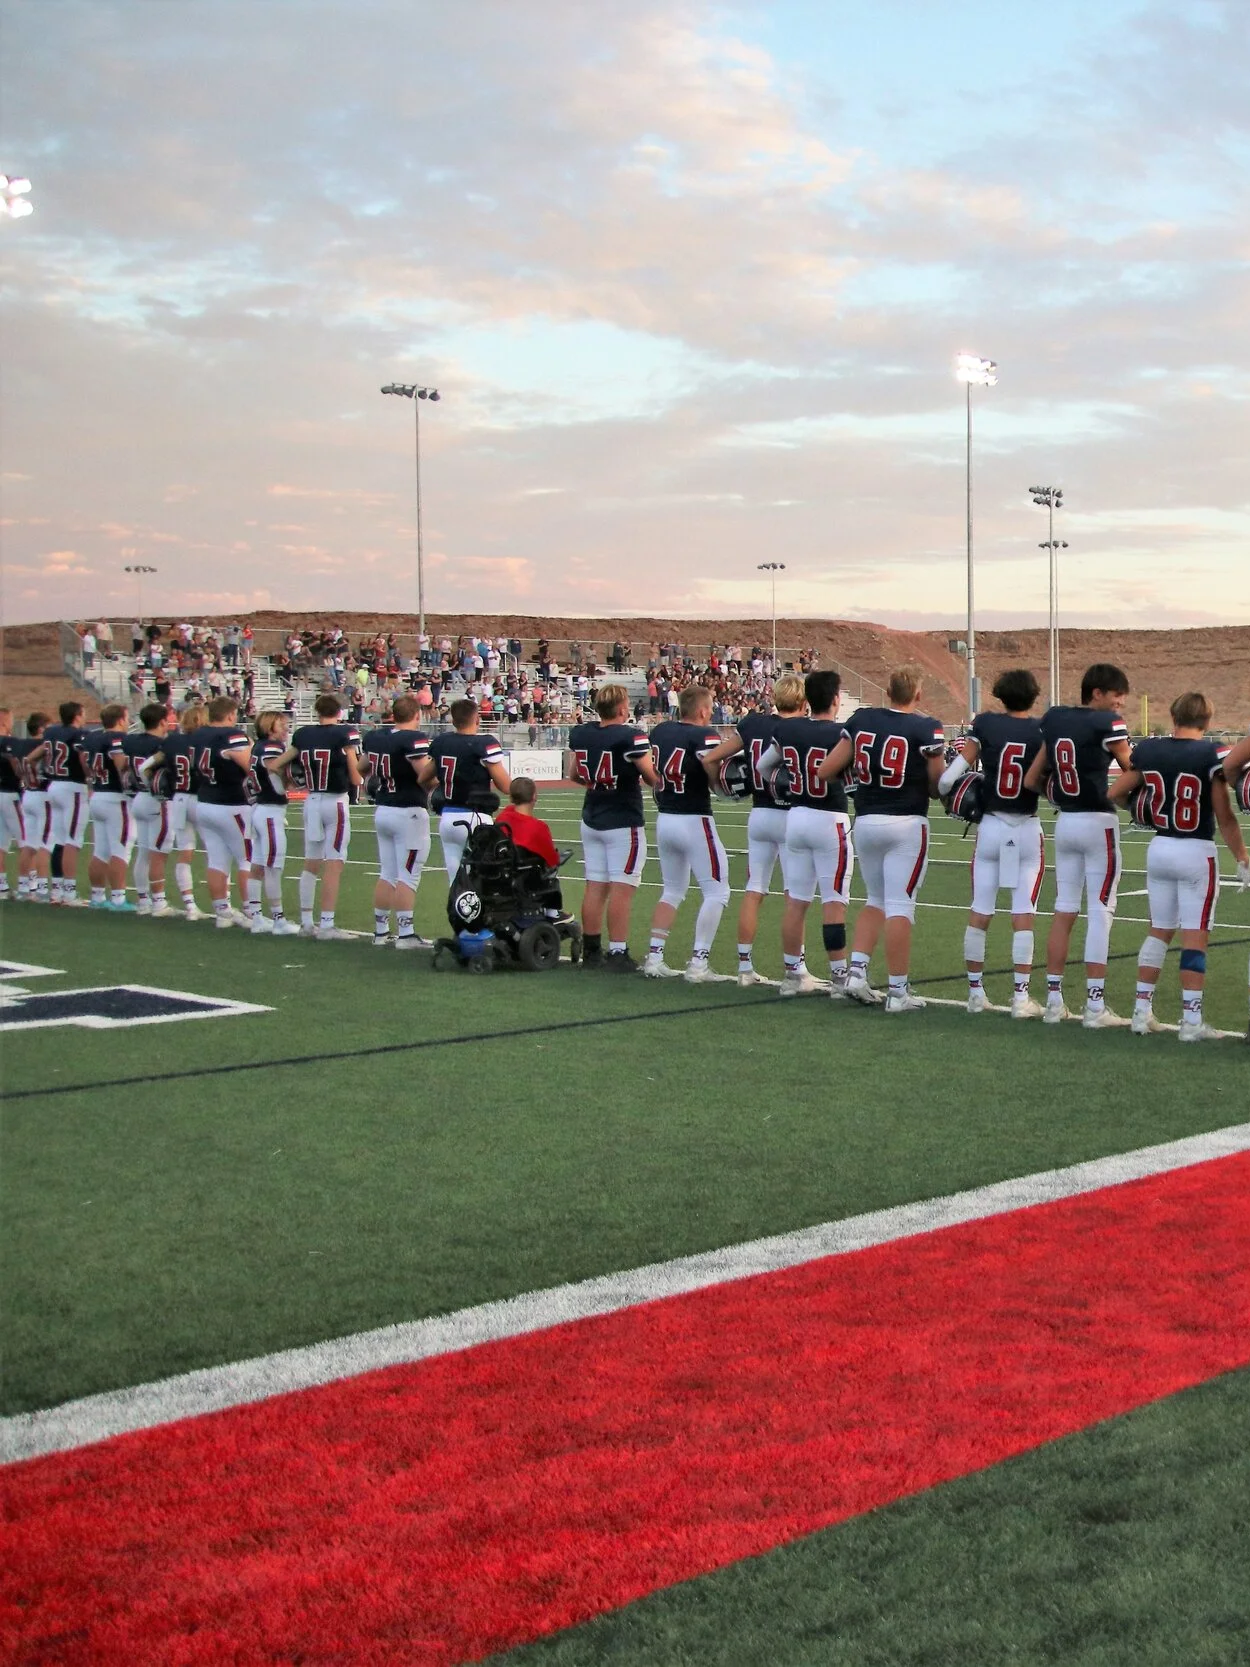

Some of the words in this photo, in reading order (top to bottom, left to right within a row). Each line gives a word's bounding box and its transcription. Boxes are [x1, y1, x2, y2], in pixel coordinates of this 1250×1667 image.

[301, 749, 331, 791] 17
[367, 751, 396, 793] 71
[441, 755, 457, 800] 7
[513, 767, 525, 775] EYE
[533, 766, 560, 774] CENTER
[574, 749, 618, 790] 54
[782, 745, 829, 799] 36
[854, 730, 908, 789] 69
[996, 742, 1026, 799] 6
[1055, 738, 1080, 796] 8
[1142, 771, 1202, 832] 28
